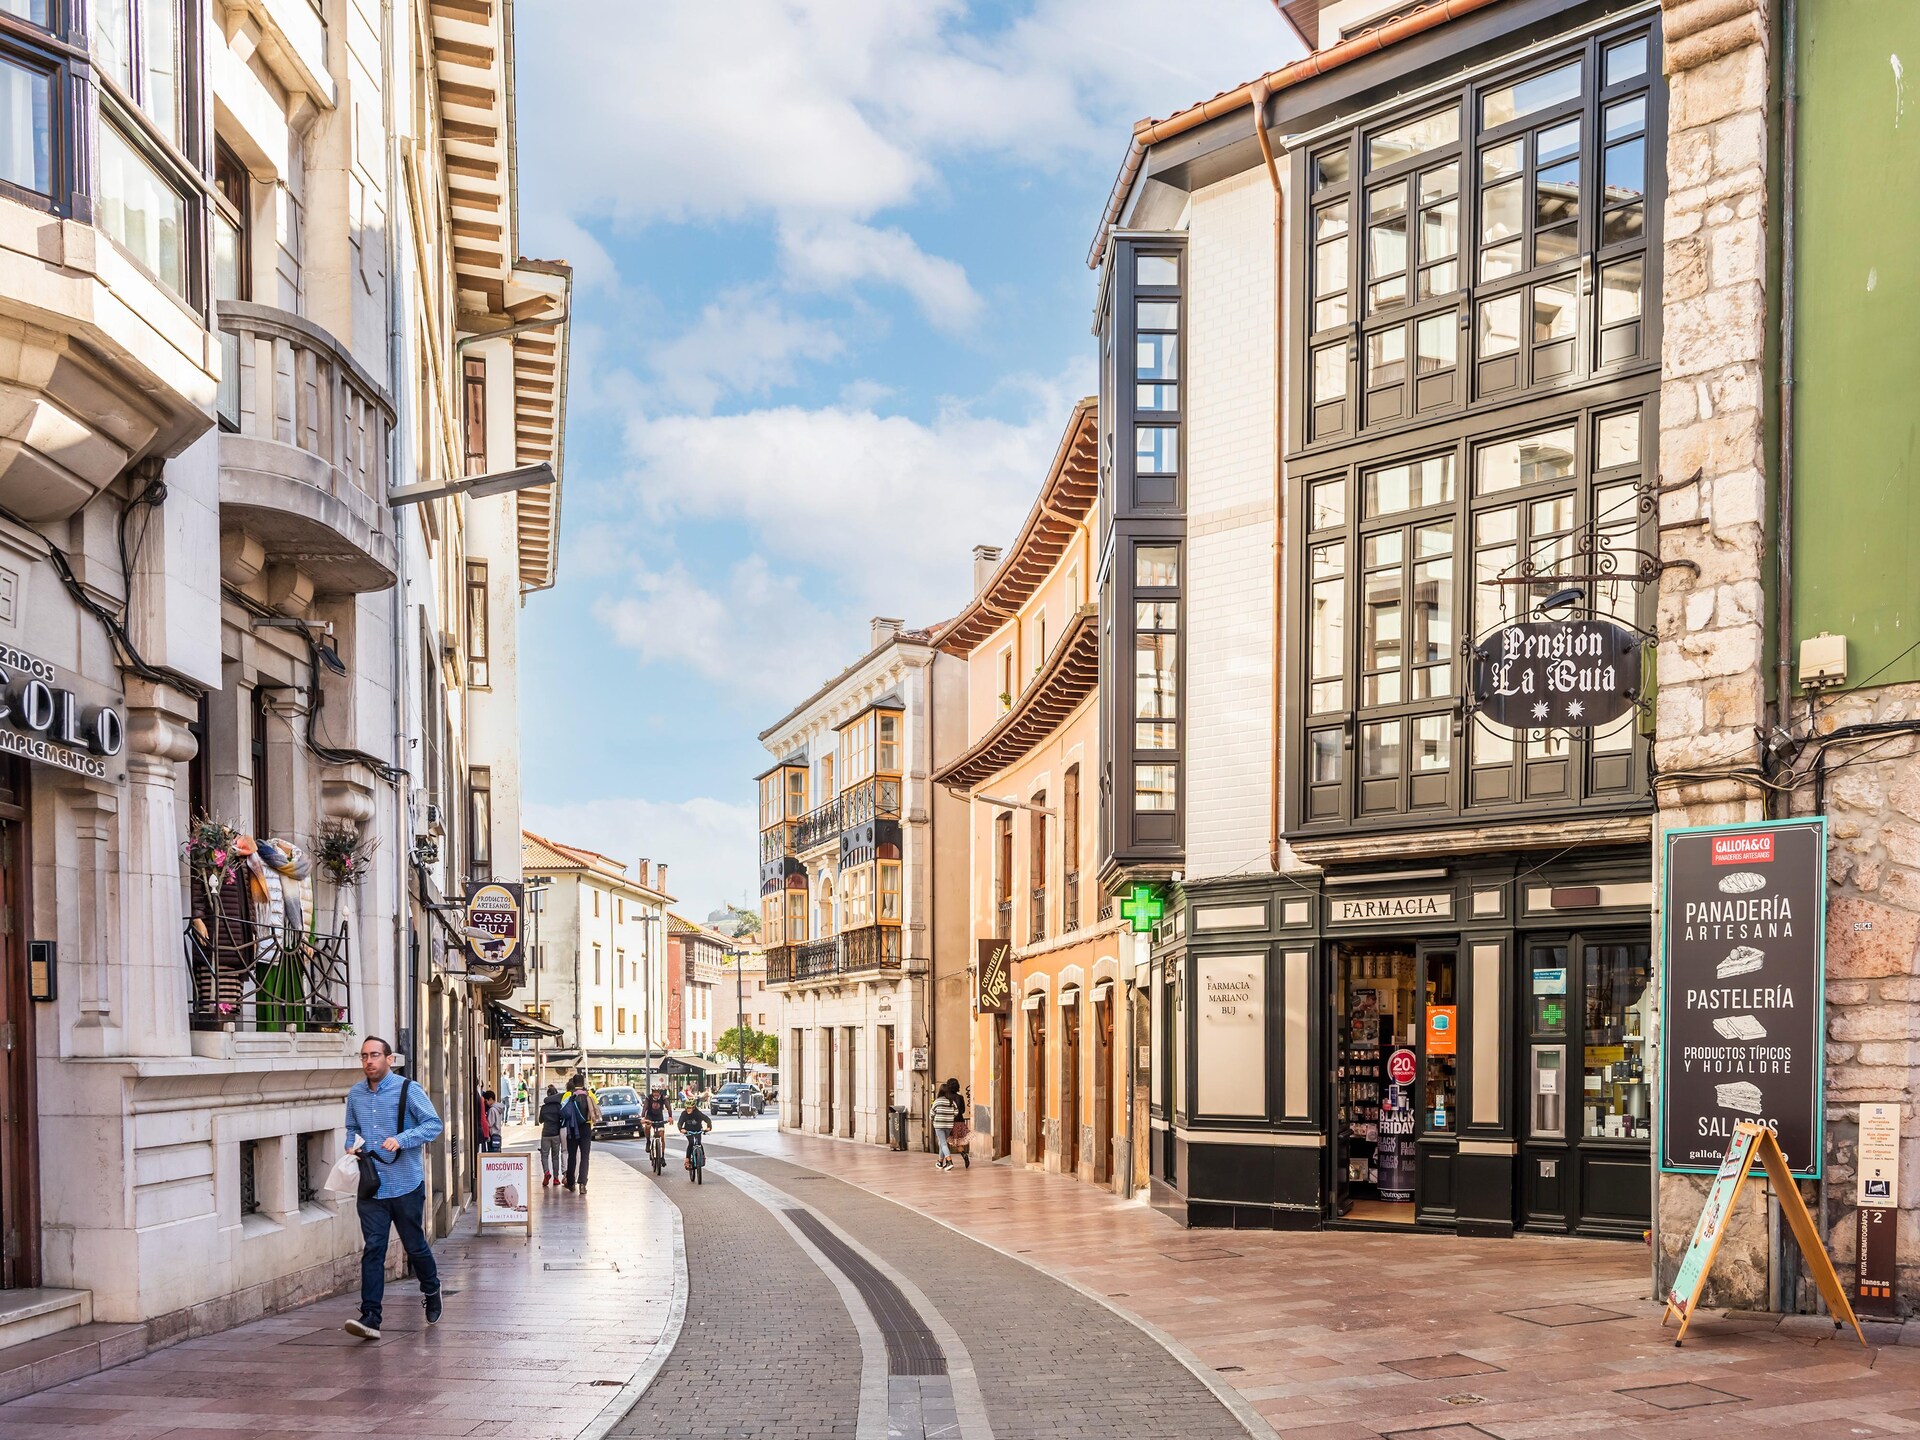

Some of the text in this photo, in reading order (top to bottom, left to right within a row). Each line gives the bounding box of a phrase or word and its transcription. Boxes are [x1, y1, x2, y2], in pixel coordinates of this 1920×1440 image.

[1503, 626, 1603, 661] Pensión
[1491, 661, 1535, 696] La
[0, 731, 105, 777] MPLEMENTOS
[1715, 838, 1770, 853] GALLOFA&CO
[1715, 851, 1770, 861] PANADEROS ARTESANOS
[1343, 898, 1437, 918] FARMACIA
[1686, 895, 1792, 923] PANADERÍA
[473, 913, 513, 923] CASA
[478, 924, 508, 934] BUJ
[1685, 922, 1793, 941] ARTESANA
[982, 947, 1001, 988] CONFITERÍA
[982, 944, 1008, 1008] Vega
[1207, 982, 1250, 990] FARMACIA
[1209, 994, 1249, 1002] MARIANO
[1687, 985, 1794, 1010] PASTELERÍA
[1222, 1007, 1236, 1015] BUJ
[1684, 1044, 1791, 1060] PRODUCTOS TÍPICOS
[1684, 1060, 1791, 1073] Y HOJALDRE
[1380, 1109, 1414, 1121] BLACK
[1380, 1121, 1414, 1134] FRIDAY
[1699, 1116, 1779, 1138] SALS
[1381, 1191, 1410, 1199] Neutrogena
[1873, 1212, 1882, 1223] 2
[1861, 1279, 1890, 1287] llanes.es
